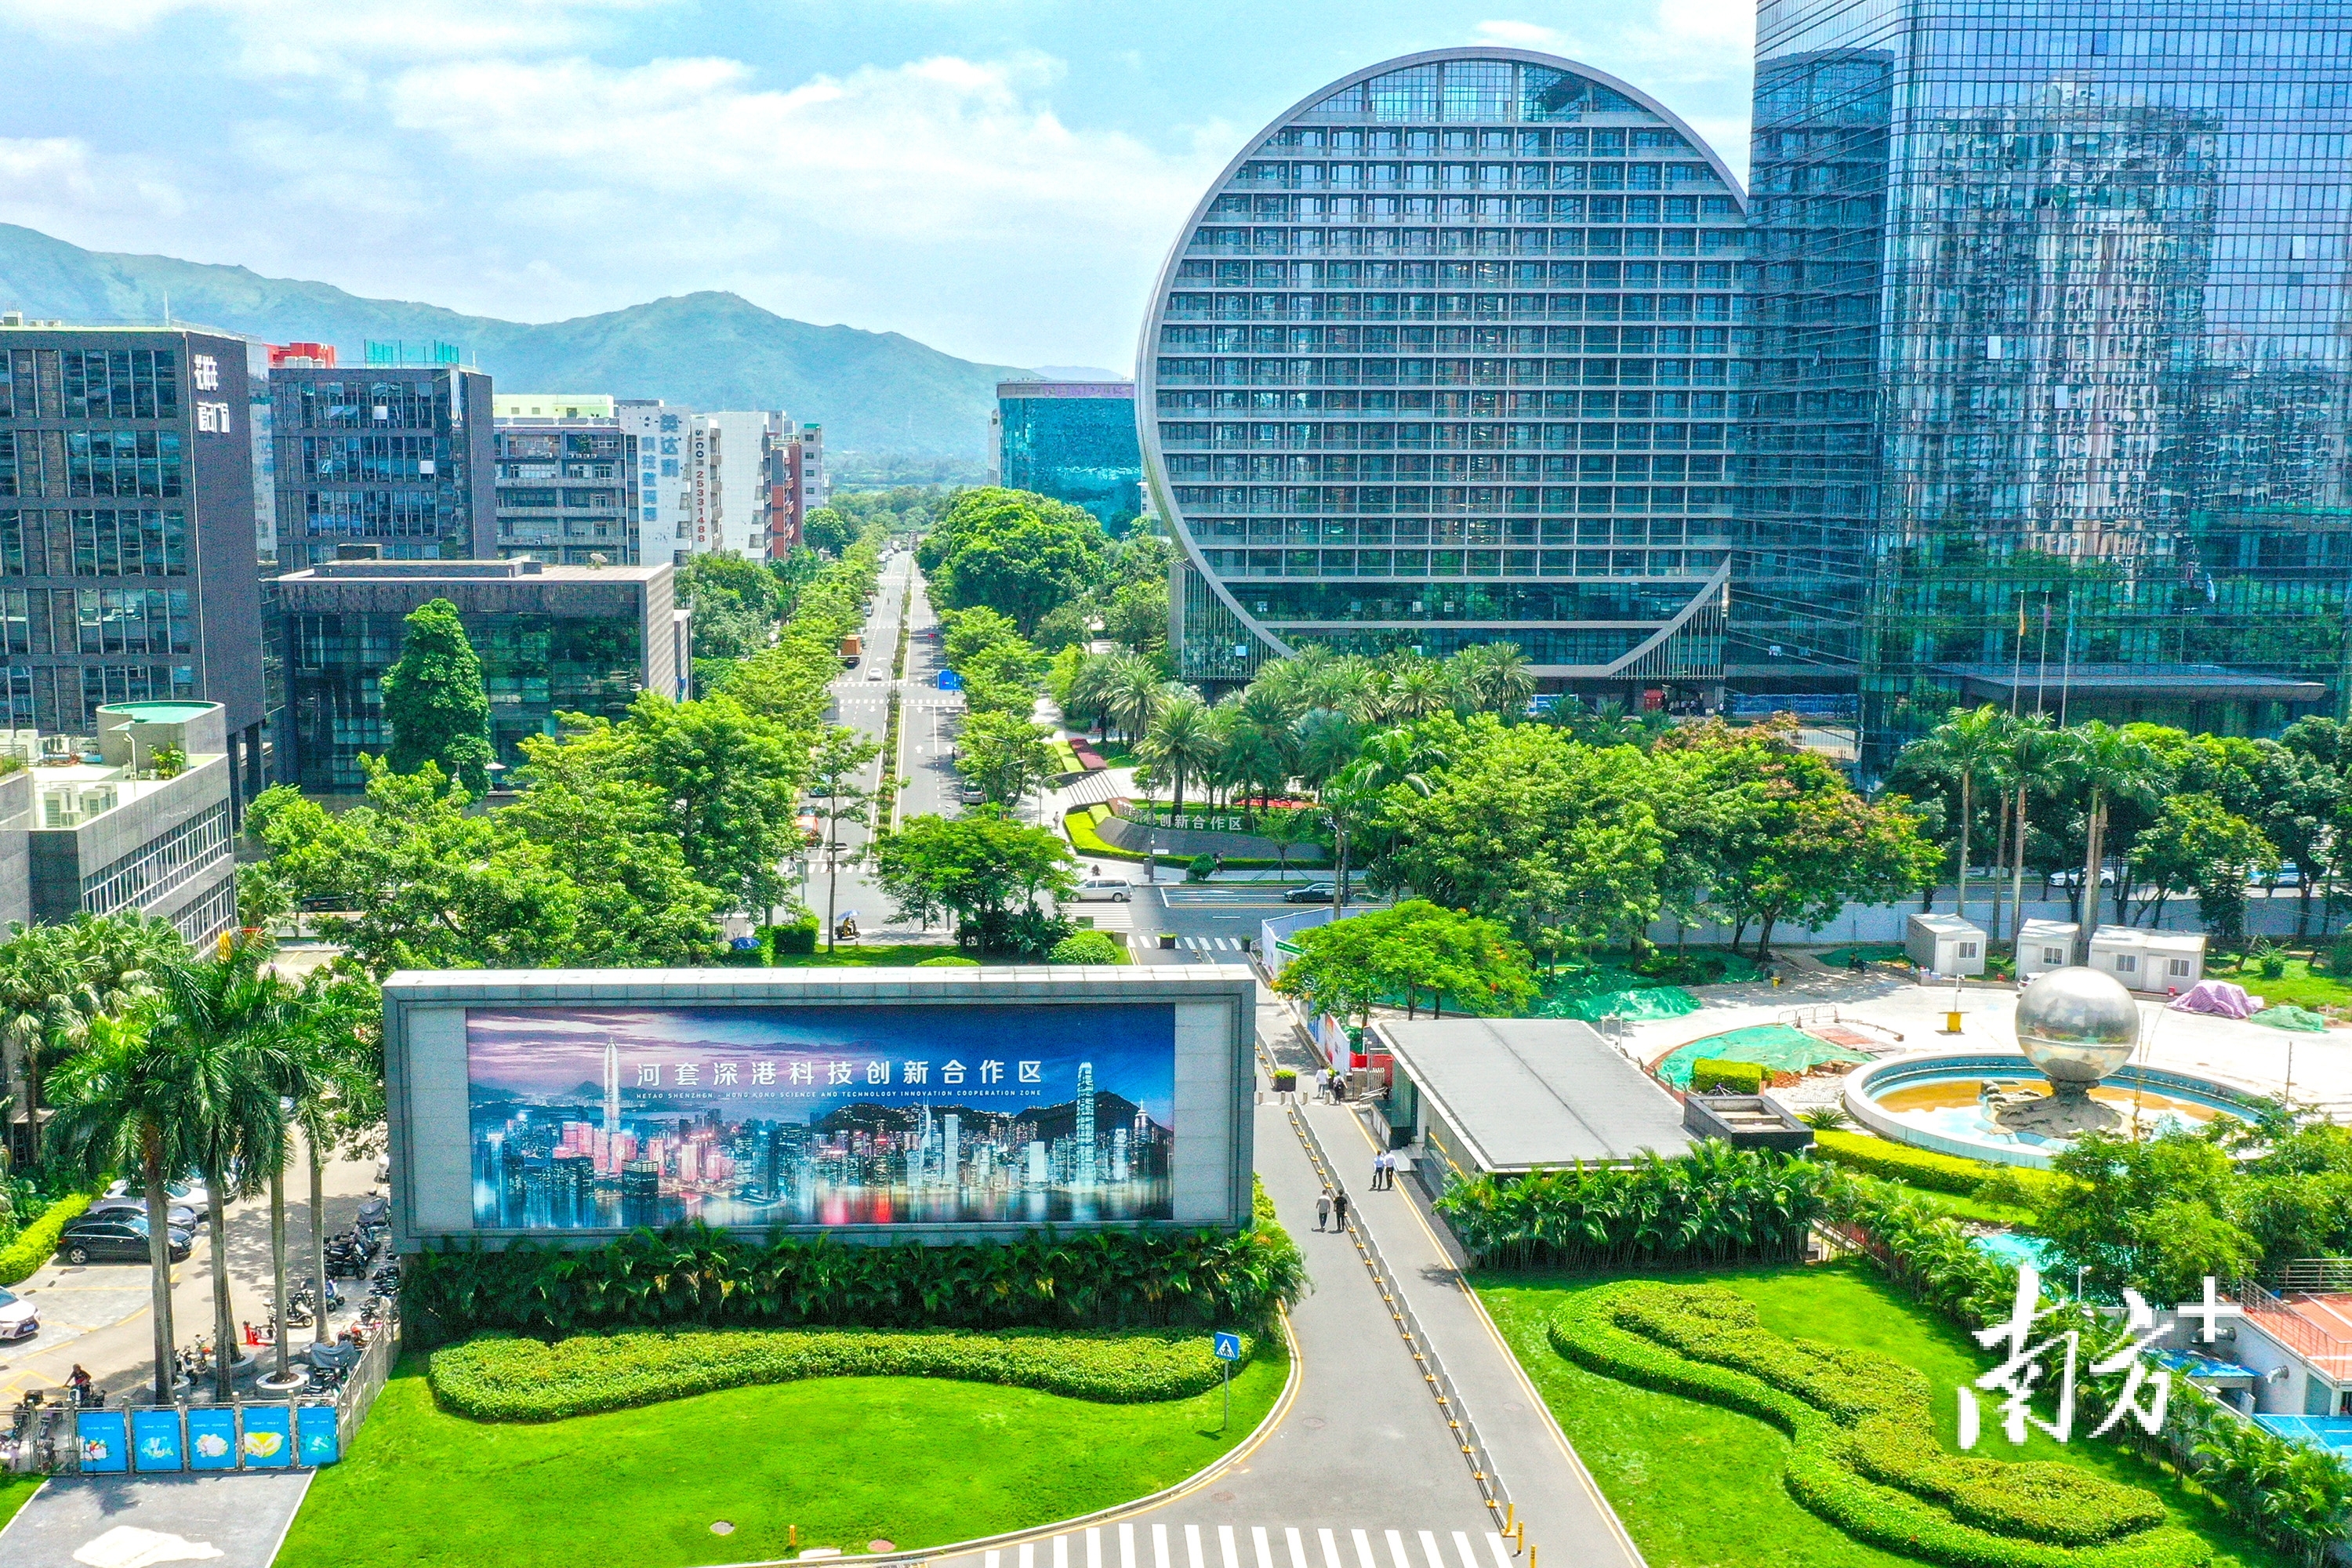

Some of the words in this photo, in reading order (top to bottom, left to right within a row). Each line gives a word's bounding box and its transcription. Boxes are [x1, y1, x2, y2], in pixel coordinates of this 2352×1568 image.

[696, 470, 706, 543] 25331488
[636, 1060, 1042, 1087] 河套深港科技创新合作区
